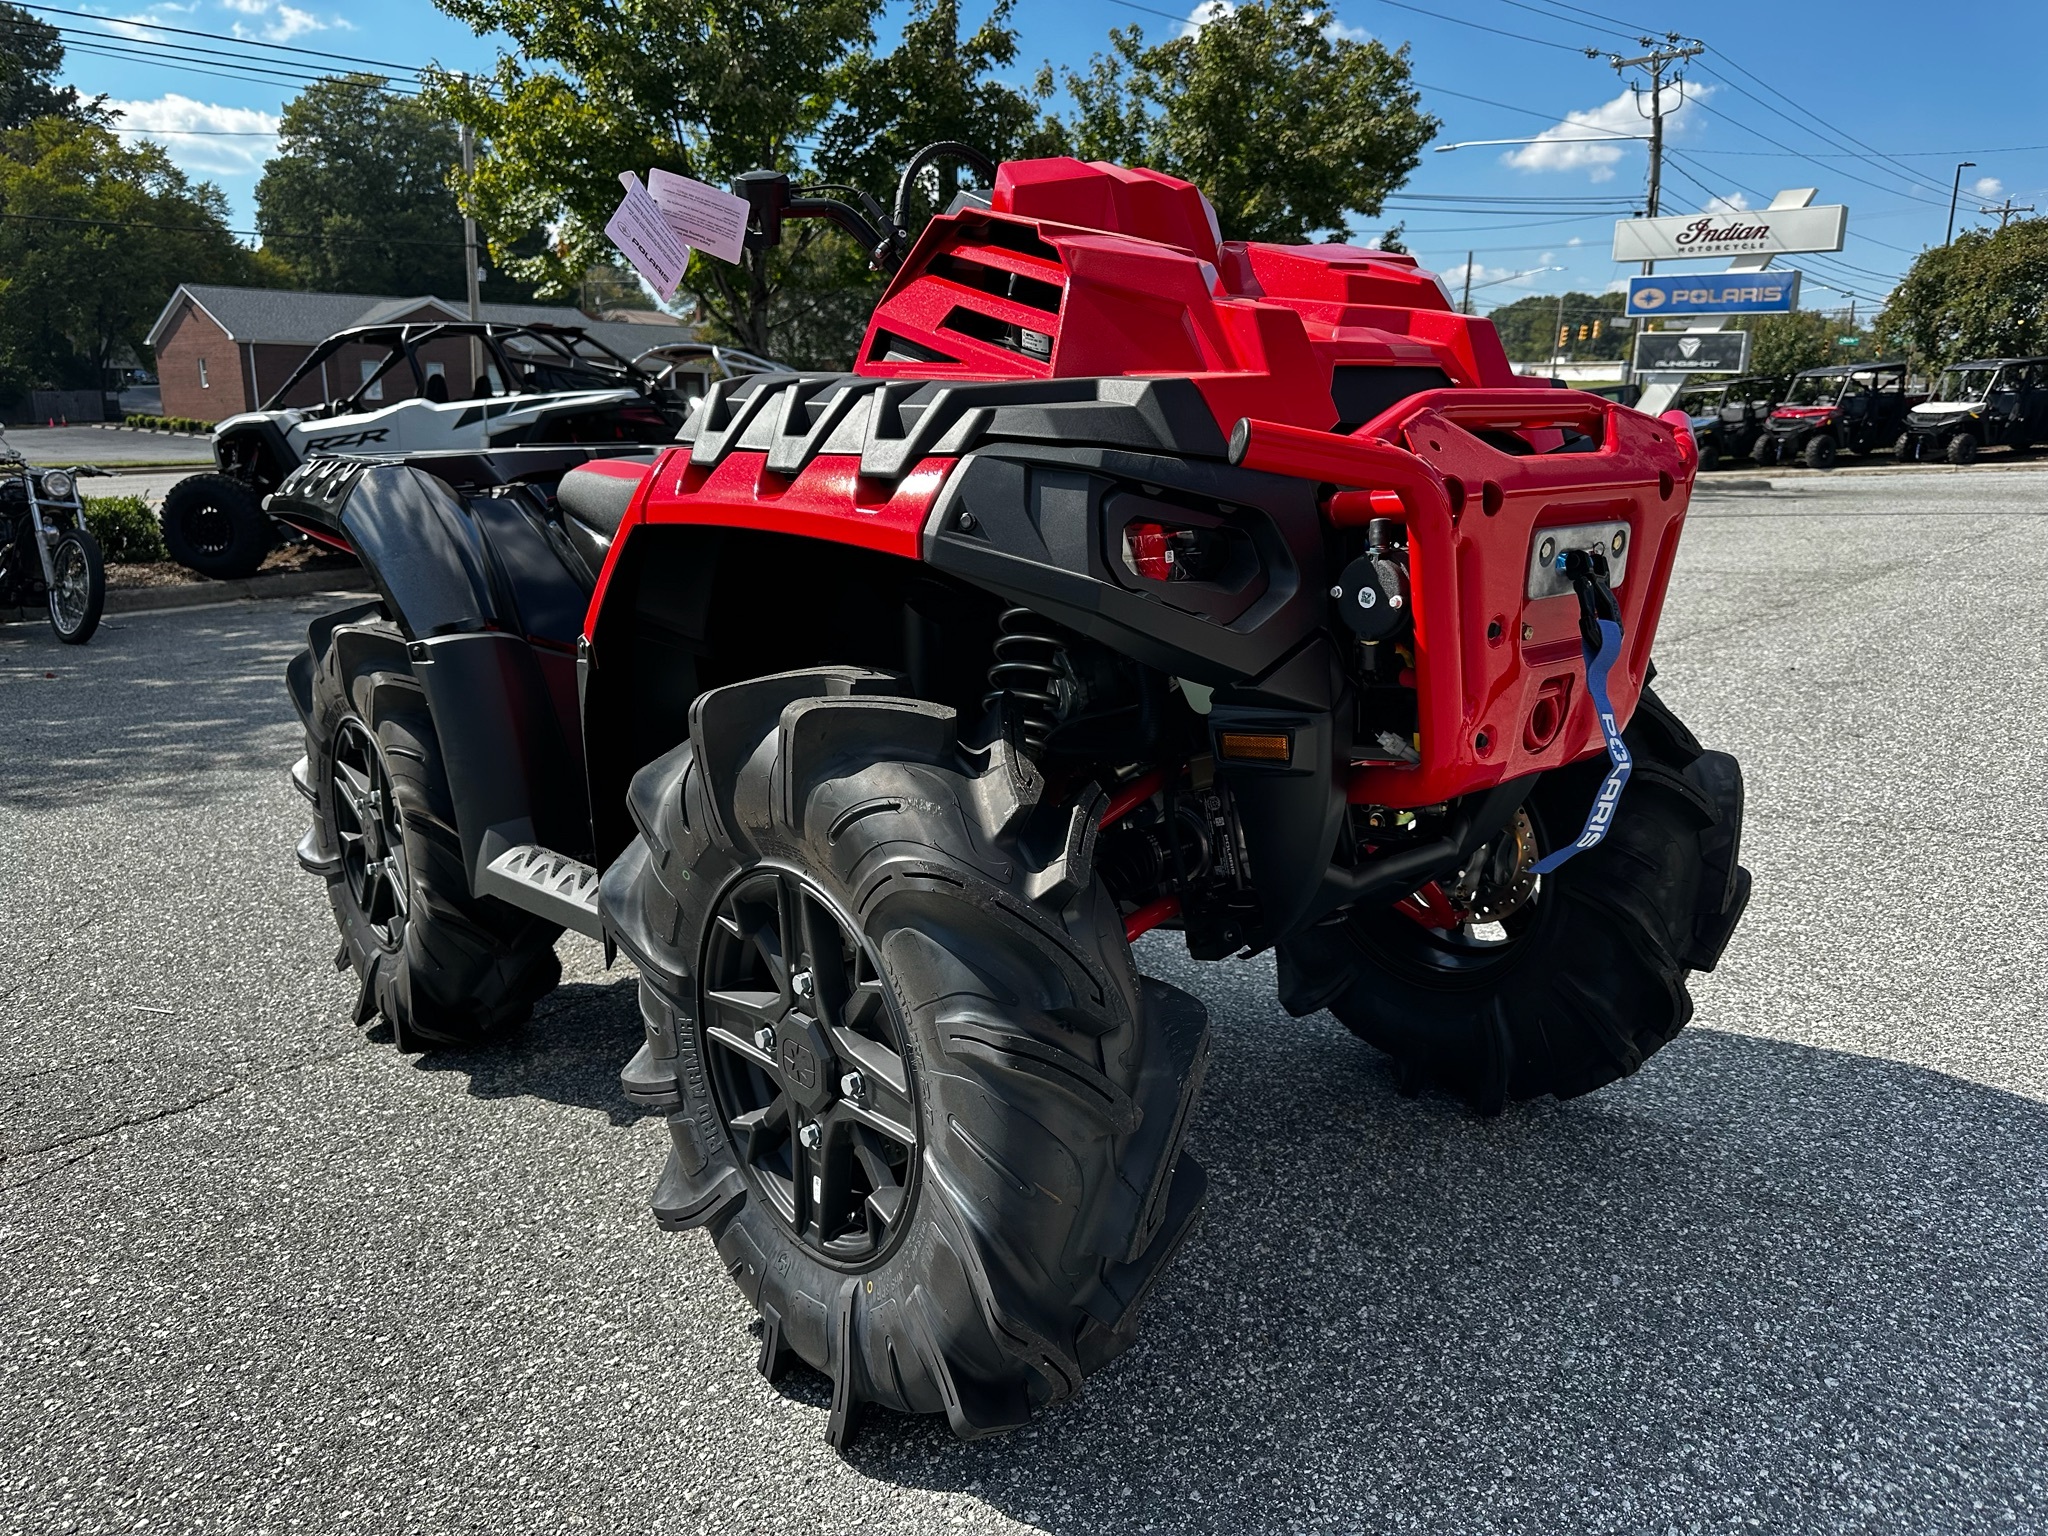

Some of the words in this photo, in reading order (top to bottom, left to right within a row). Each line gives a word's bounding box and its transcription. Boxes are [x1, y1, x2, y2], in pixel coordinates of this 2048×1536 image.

[1675, 218, 1770, 245] Indian
[1678, 242, 1764, 253] MOTORCYCLE
[631, 238, 670, 283] POLARIS
[1672, 287, 1782, 304] POLARIS
[303, 427, 391, 456] RZR
[1577, 713, 1630, 848] POLARIS
[678, 1017, 707, 1099] ARMOR
[697, 1103, 724, 1155] PRO
